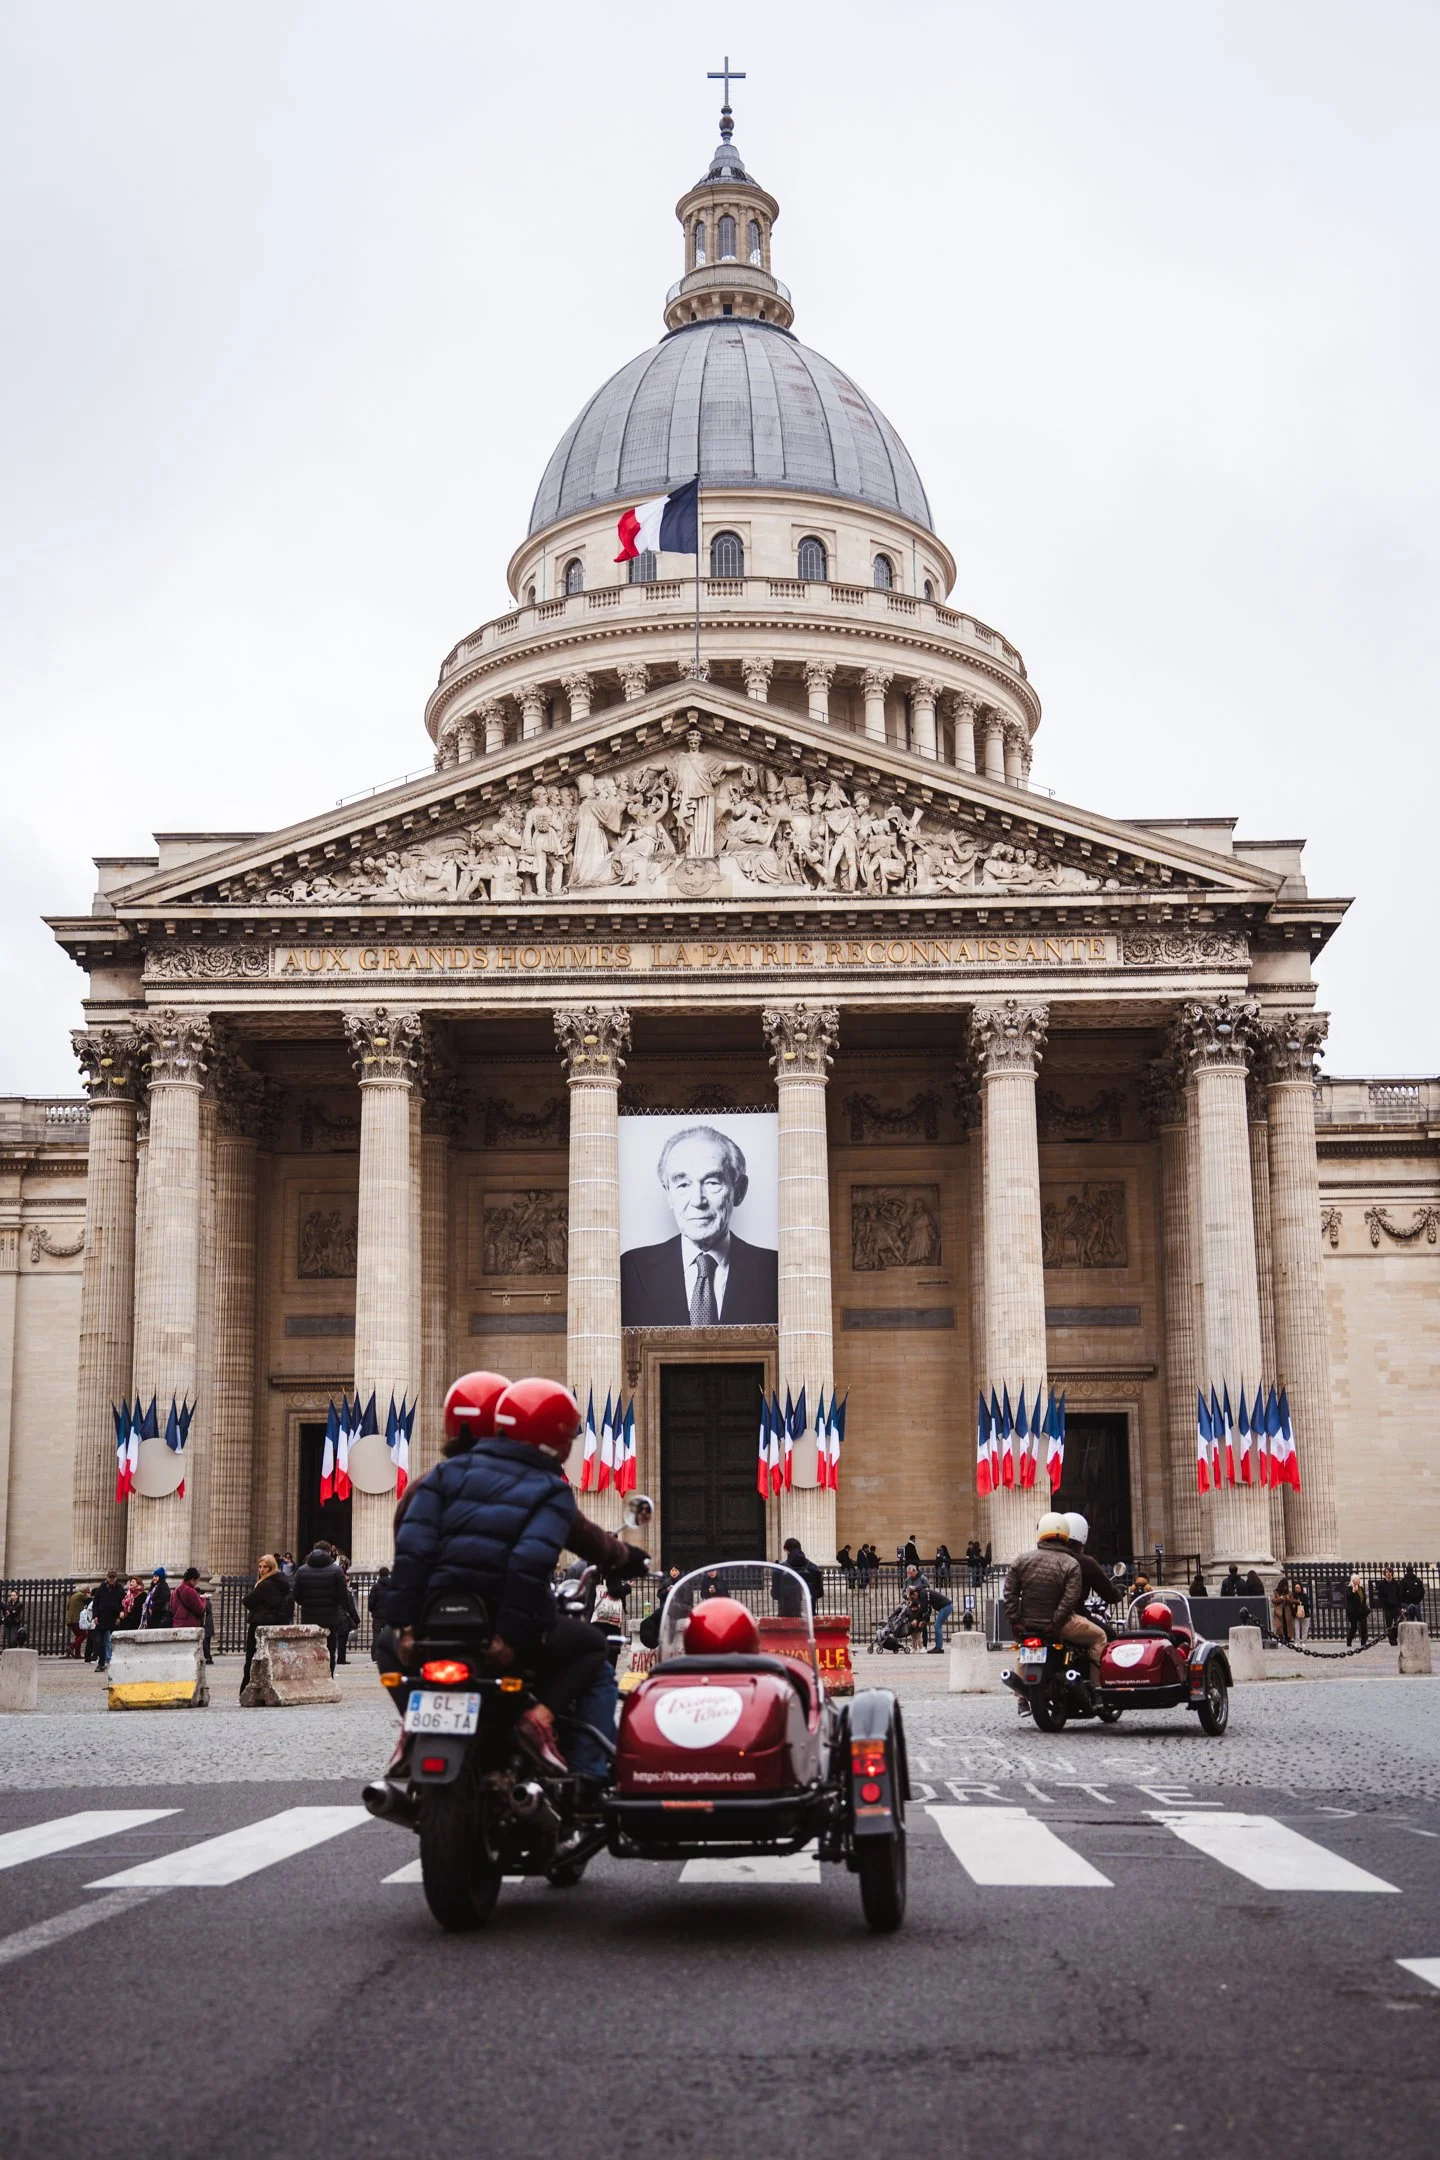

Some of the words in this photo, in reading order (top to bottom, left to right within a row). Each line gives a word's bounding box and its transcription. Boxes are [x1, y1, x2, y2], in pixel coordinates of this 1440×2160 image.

[281, 949, 350, 971] AUX
[359, 947, 489, 970] GRANDS
[496, 945, 632, 969] HOMMES
[651, 943, 692, 967] LA
[701, 942, 814, 966] PATRIE
[825, 937, 1107, 965] RECONNAISSANTE
[632, 1770, 756, 1783] https://txangotours.com
